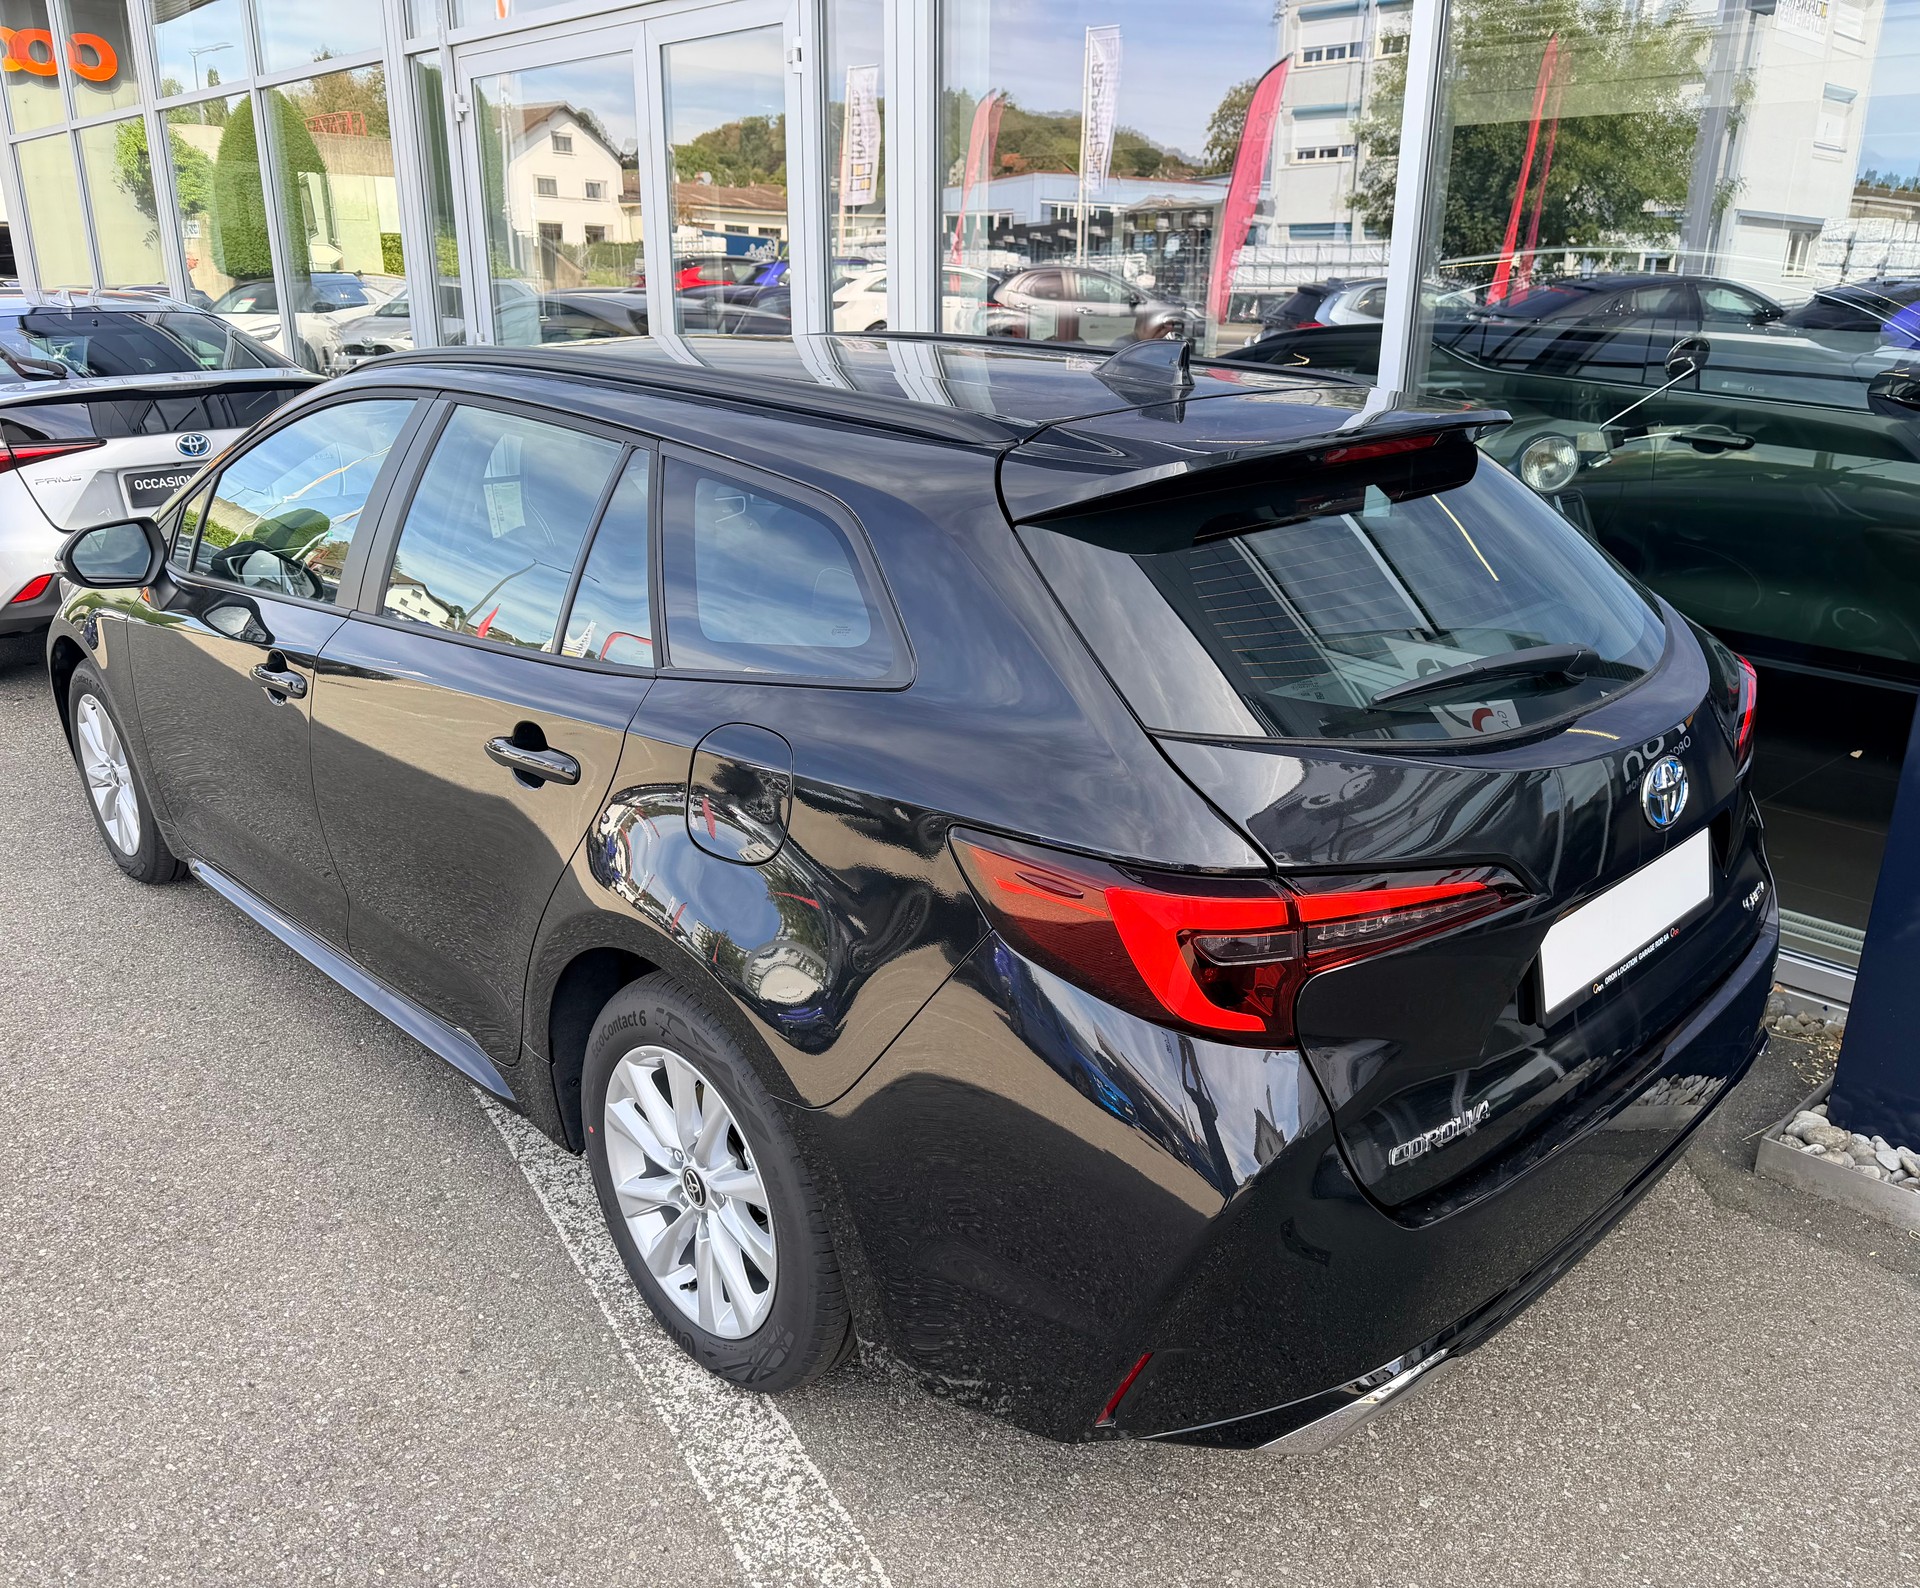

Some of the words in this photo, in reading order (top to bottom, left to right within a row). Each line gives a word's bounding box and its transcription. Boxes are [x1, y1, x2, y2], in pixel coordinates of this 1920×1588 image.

[34, 474, 83, 486] PRIUS
[1605, 972, 1618, 985] ORON
[1617, 956, 1638, 976] LOCATION
[1638, 942, 1655, 960] GARAGE
[591, 1010, 639, 1060] EcoContact
[639, 1009, 647, 1027] 6
[1389, 1100, 1490, 1166] COROLLA
